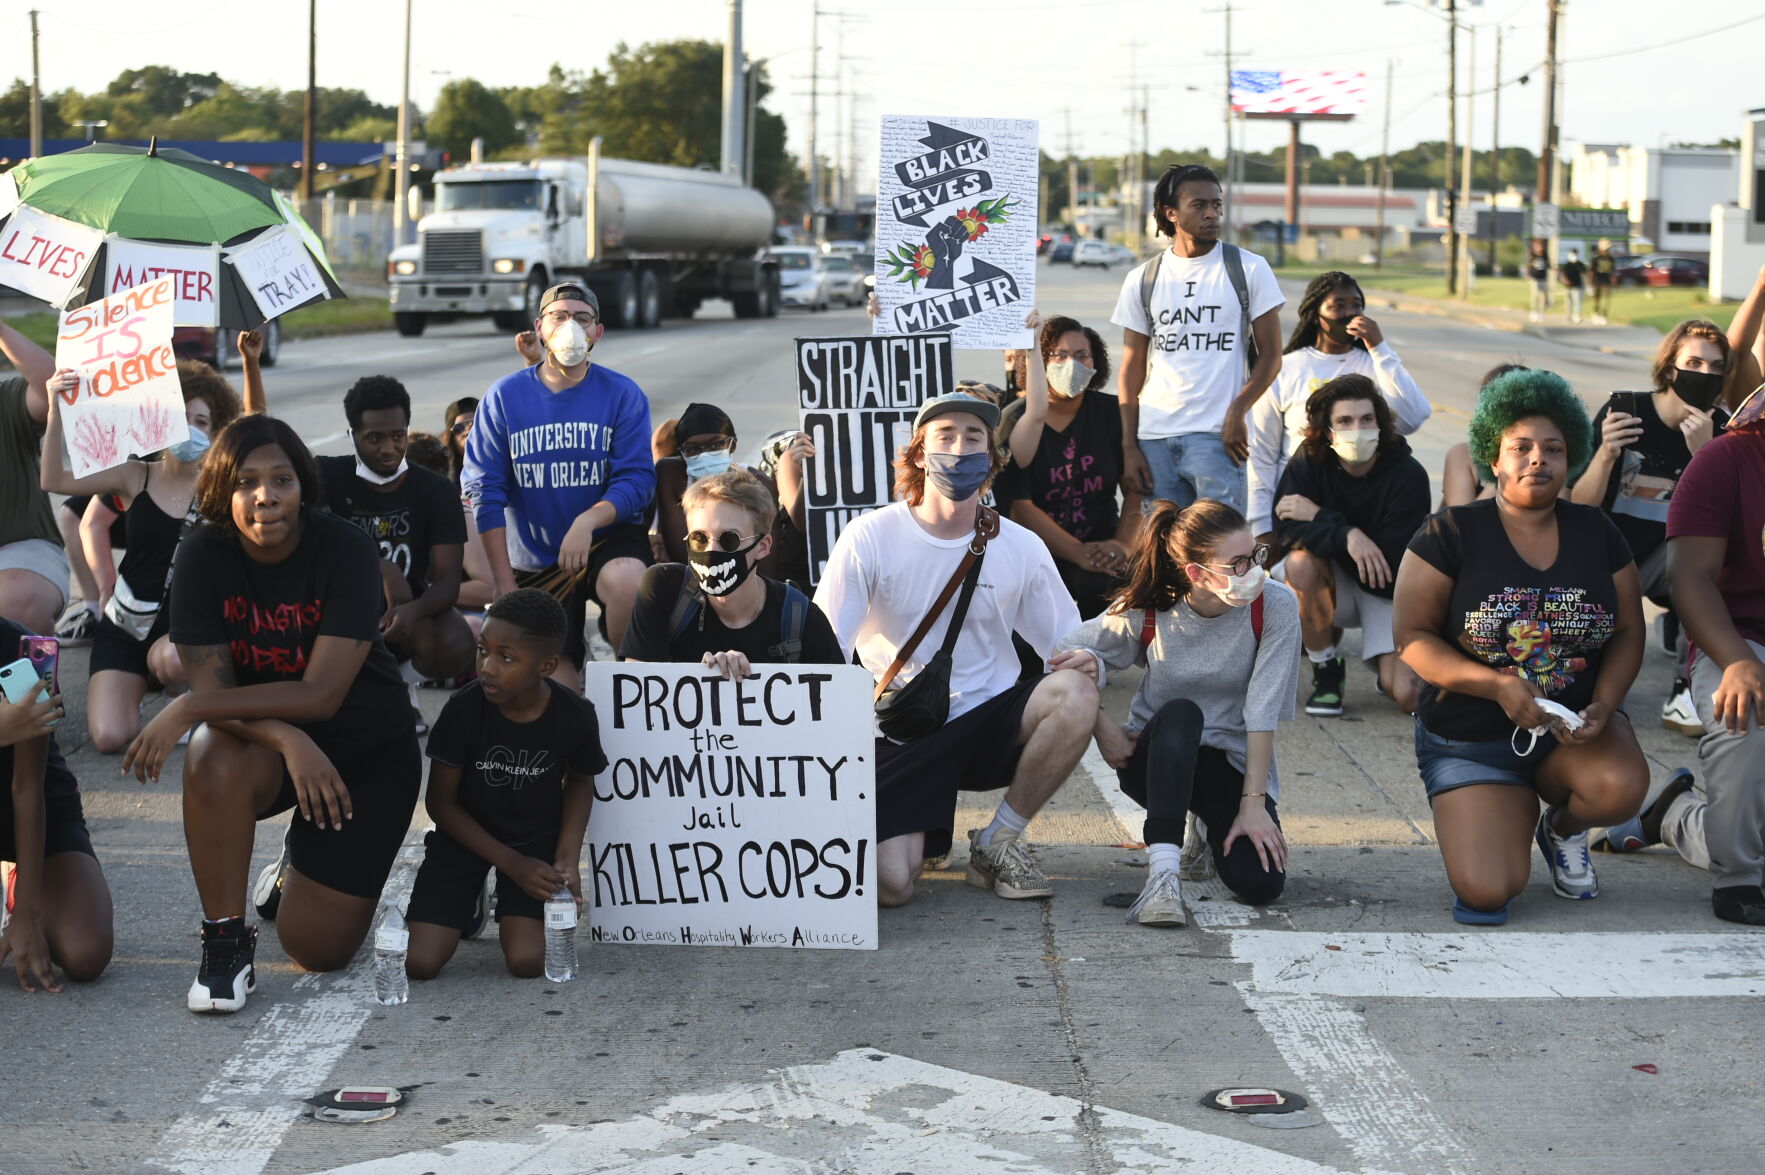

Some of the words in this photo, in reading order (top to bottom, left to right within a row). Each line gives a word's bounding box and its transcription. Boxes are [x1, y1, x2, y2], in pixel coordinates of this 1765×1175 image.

[904, 139, 987, 182] BLACK
[893, 173, 982, 217] LIVES
[1, 230, 86, 279] LIVES
[258, 263, 316, 308] TRAY!
[1184, 281, 1197, 298] I
[60, 280, 171, 341] Silence
[895, 276, 1017, 334] MATTER
[1159, 305, 1222, 326] CAN'T
[82, 316, 147, 366] IS
[1154, 332, 1236, 353] REATHE
[801, 337, 950, 409] STRAIGHT
[510, 421, 599, 460] UNIVERSITY
[602, 425, 614, 453] OF
[513, 461, 545, 489] NEW
[1487, 594, 1540, 602] STRONG
[1545, 593, 1581, 602] PRIDE
[1503, 586, 1541, 595] SMART
[1480, 602, 1521, 612] BLACK
[1528, 602, 1538, 612] IS
[1544, 602, 1606, 613] BEAUTIFUL
[1514, 611, 1580, 621] GREATNESS
[1464, 623, 1500, 632] PRIDE
[1552, 628, 1588, 636] SWEET
[1468, 629, 1500, 638] QUEEN
[1551, 620, 1591, 629] UNIQUE
[612, 672, 833, 731] PROTECT
[689, 728, 739, 753] the
[475, 761, 505, 771] CALVIN
[504, 765, 530, 776] KLEIN
[484, 744, 549, 790] CK
[682, 802, 742, 831] Jail
[589, 840, 729, 908] KILLER
[738, 837, 868, 900] COPS!
[591, 925, 620, 943] New
[622, 925, 677, 943] Orleans
[739, 924, 787, 946] Workers
[791, 926, 865, 947] Alliance
